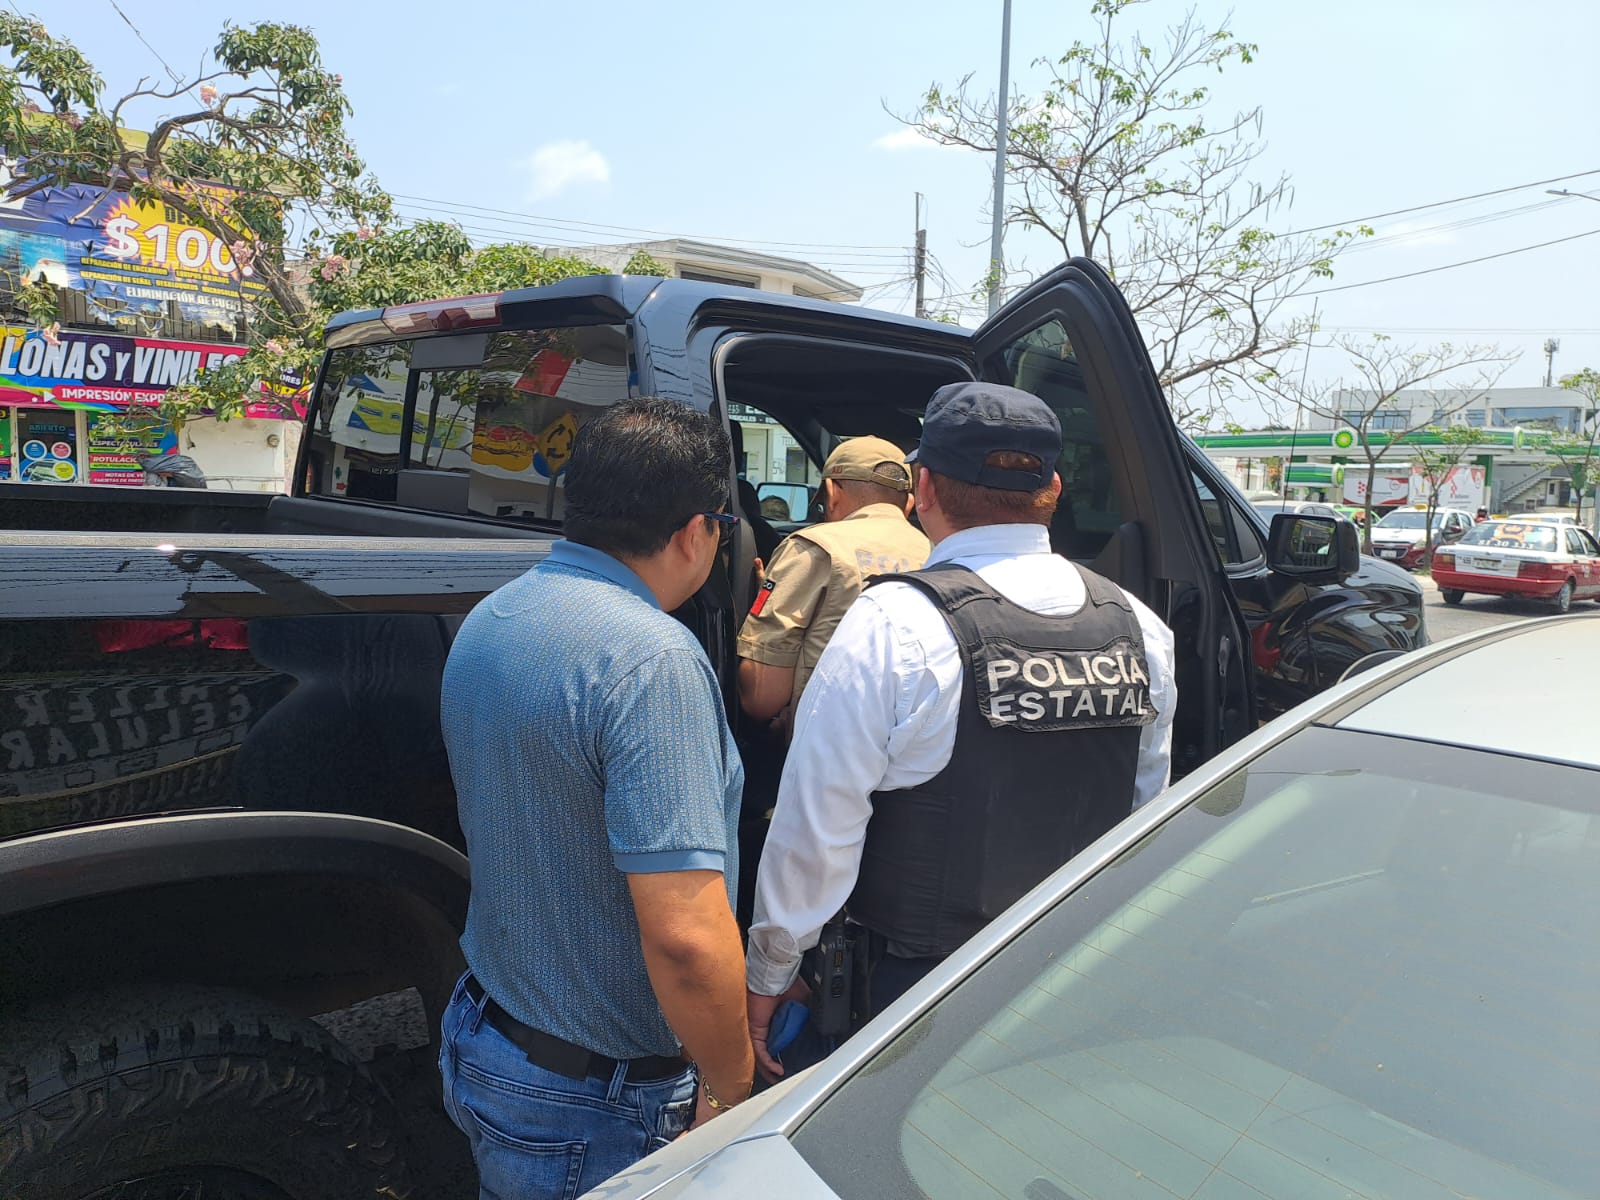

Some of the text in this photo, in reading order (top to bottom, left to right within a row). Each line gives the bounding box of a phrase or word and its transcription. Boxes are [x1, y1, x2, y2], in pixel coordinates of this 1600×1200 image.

[126, 286, 196, 304] ELIMINACIÓN
[197, 294, 211, 306] DE
[1, 336, 112, 382] LONAS
[61, 387, 132, 403] IMPRESIÓN
[986, 650, 1149, 693] POLICÍA
[990, 688, 1148, 722] ESTATAL
